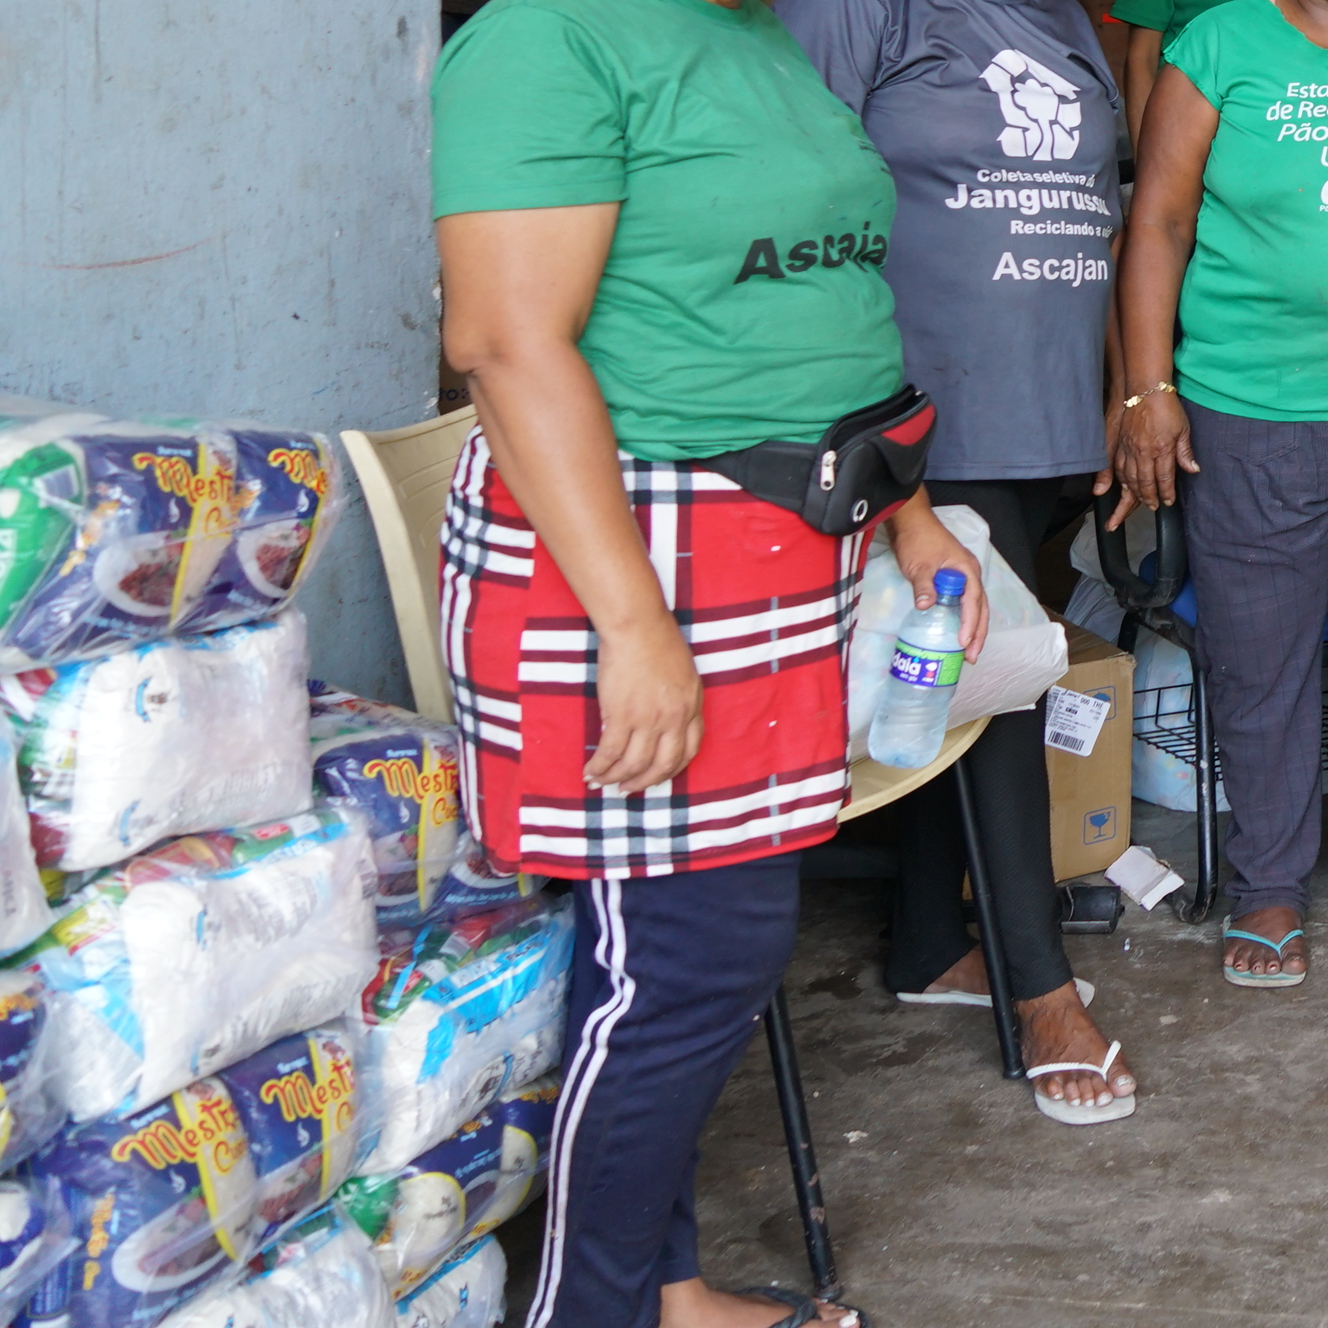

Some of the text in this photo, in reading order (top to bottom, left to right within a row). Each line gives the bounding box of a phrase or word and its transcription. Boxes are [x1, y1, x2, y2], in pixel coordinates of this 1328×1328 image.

[1266, 101, 1294, 121] de
[977, 169, 1033, 183] Coleta
[944, 184, 1111, 216] Jangurussu
[1010, 220, 1095, 236] Reciclando
[733, 221, 888, 285] Ascaja
[992, 252, 1109, 287] Ascajan
